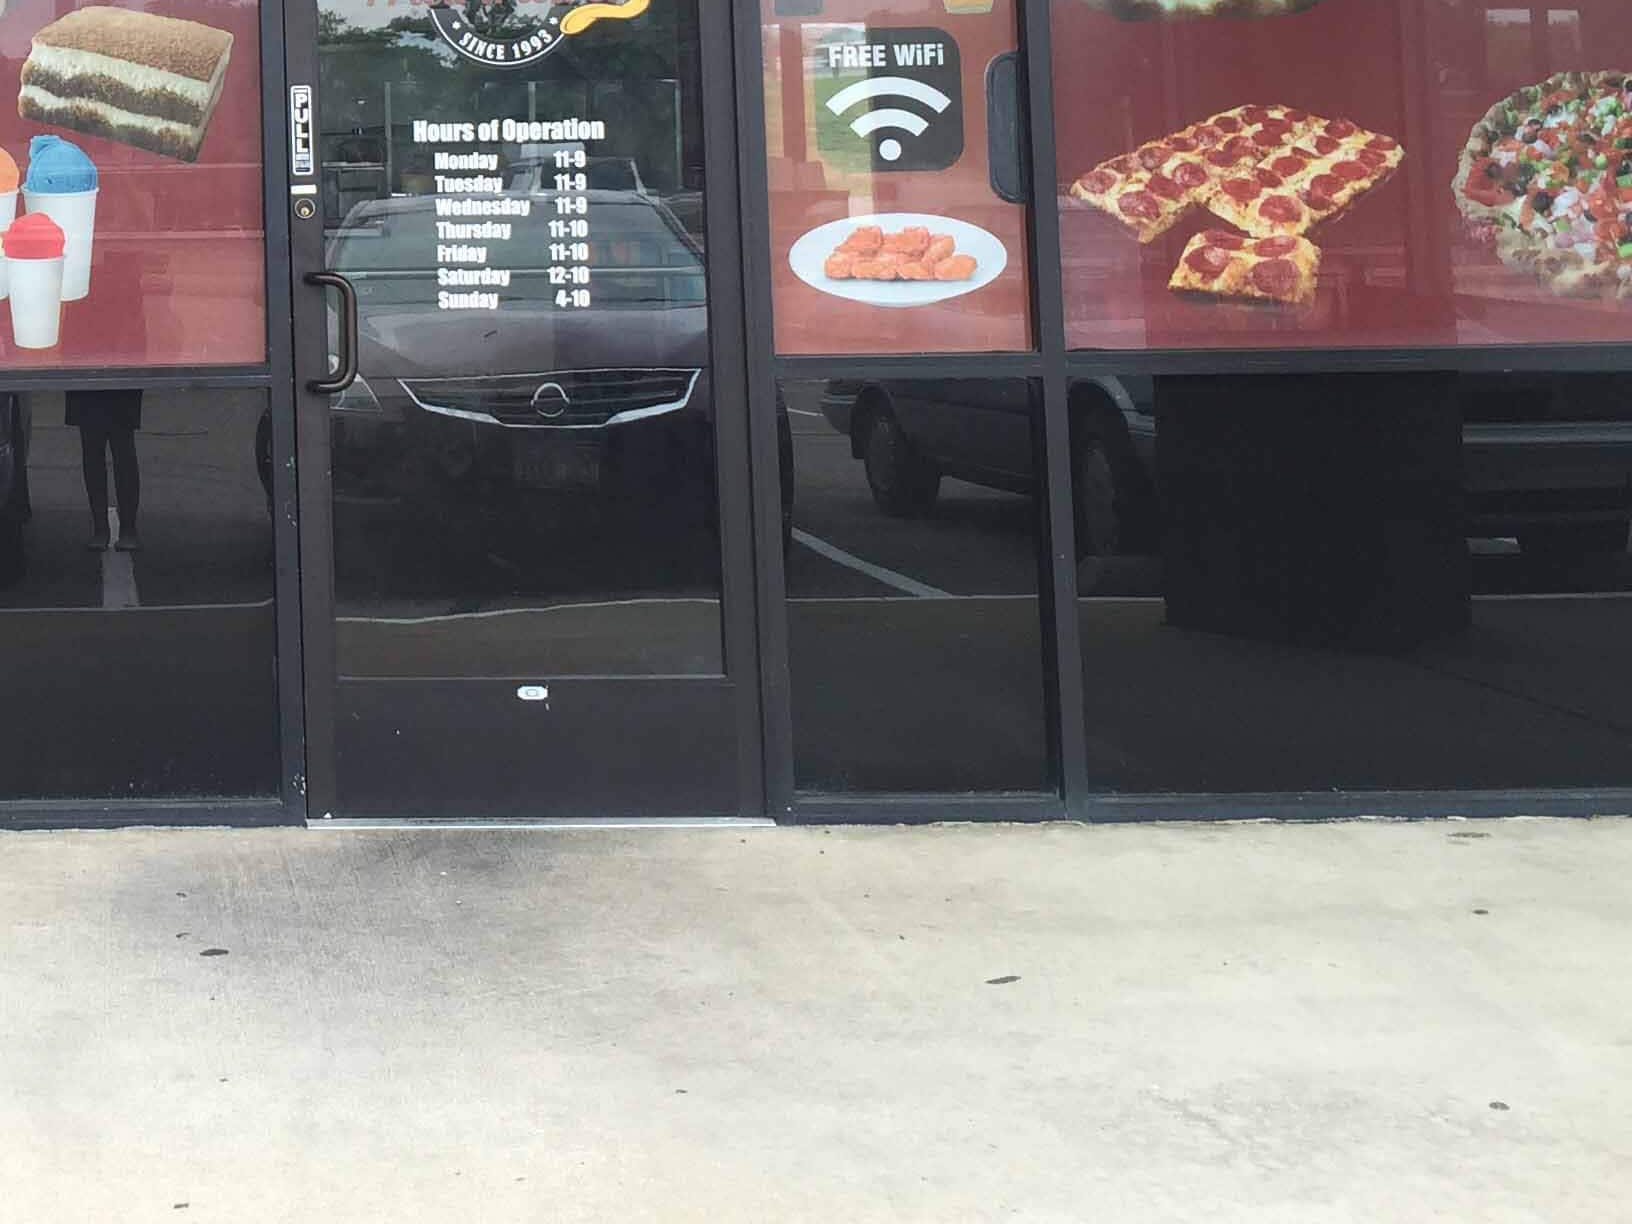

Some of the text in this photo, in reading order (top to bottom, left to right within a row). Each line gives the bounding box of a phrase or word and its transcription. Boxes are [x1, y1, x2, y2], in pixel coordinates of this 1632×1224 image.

[459, 29, 553, 60] SINCE 1993
[829, 43, 944, 68] FREE WiFi
[294, 93, 309, 153] PULL
[413, 118, 605, 143] Hours of Operation
[434, 150, 586, 171] Monday 11-9
[434, 173, 587, 194] Tuesday 11-9
[435, 196, 587, 216] Wednesday 11-9
[436, 219, 589, 240] Thursday 11-10
[437, 243, 589, 263] Friday 11-10
[437, 266, 590, 286] Saturday 12-10
[438, 289, 591, 309] Sunday 4-10
